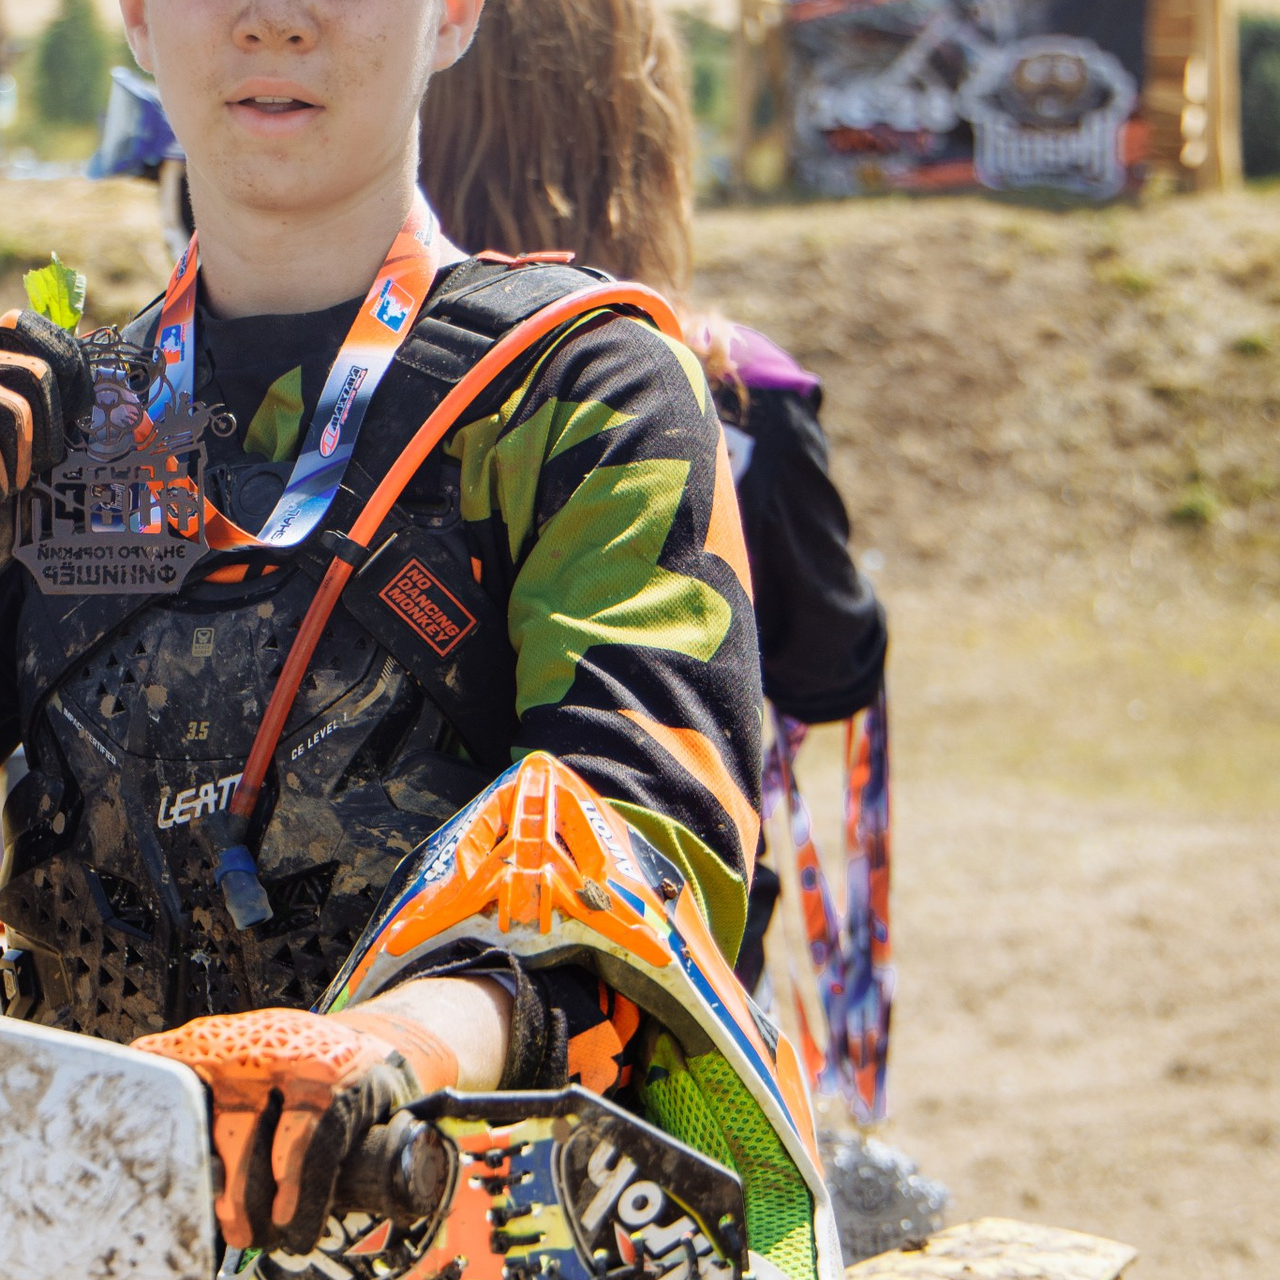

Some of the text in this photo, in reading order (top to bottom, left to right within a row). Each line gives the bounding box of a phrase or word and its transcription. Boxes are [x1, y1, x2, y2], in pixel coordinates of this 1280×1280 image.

[406, 568, 432, 590] NO
[387, 587, 450, 642] MONKEY
[397, 577, 460, 637] DANCING
[84, 731, 117, 765] CERTIFIED
[186, 721, 210, 740] 3.5
[291, 745, 305, 761] CE
[307, 718, 339, 749] LEVEL
